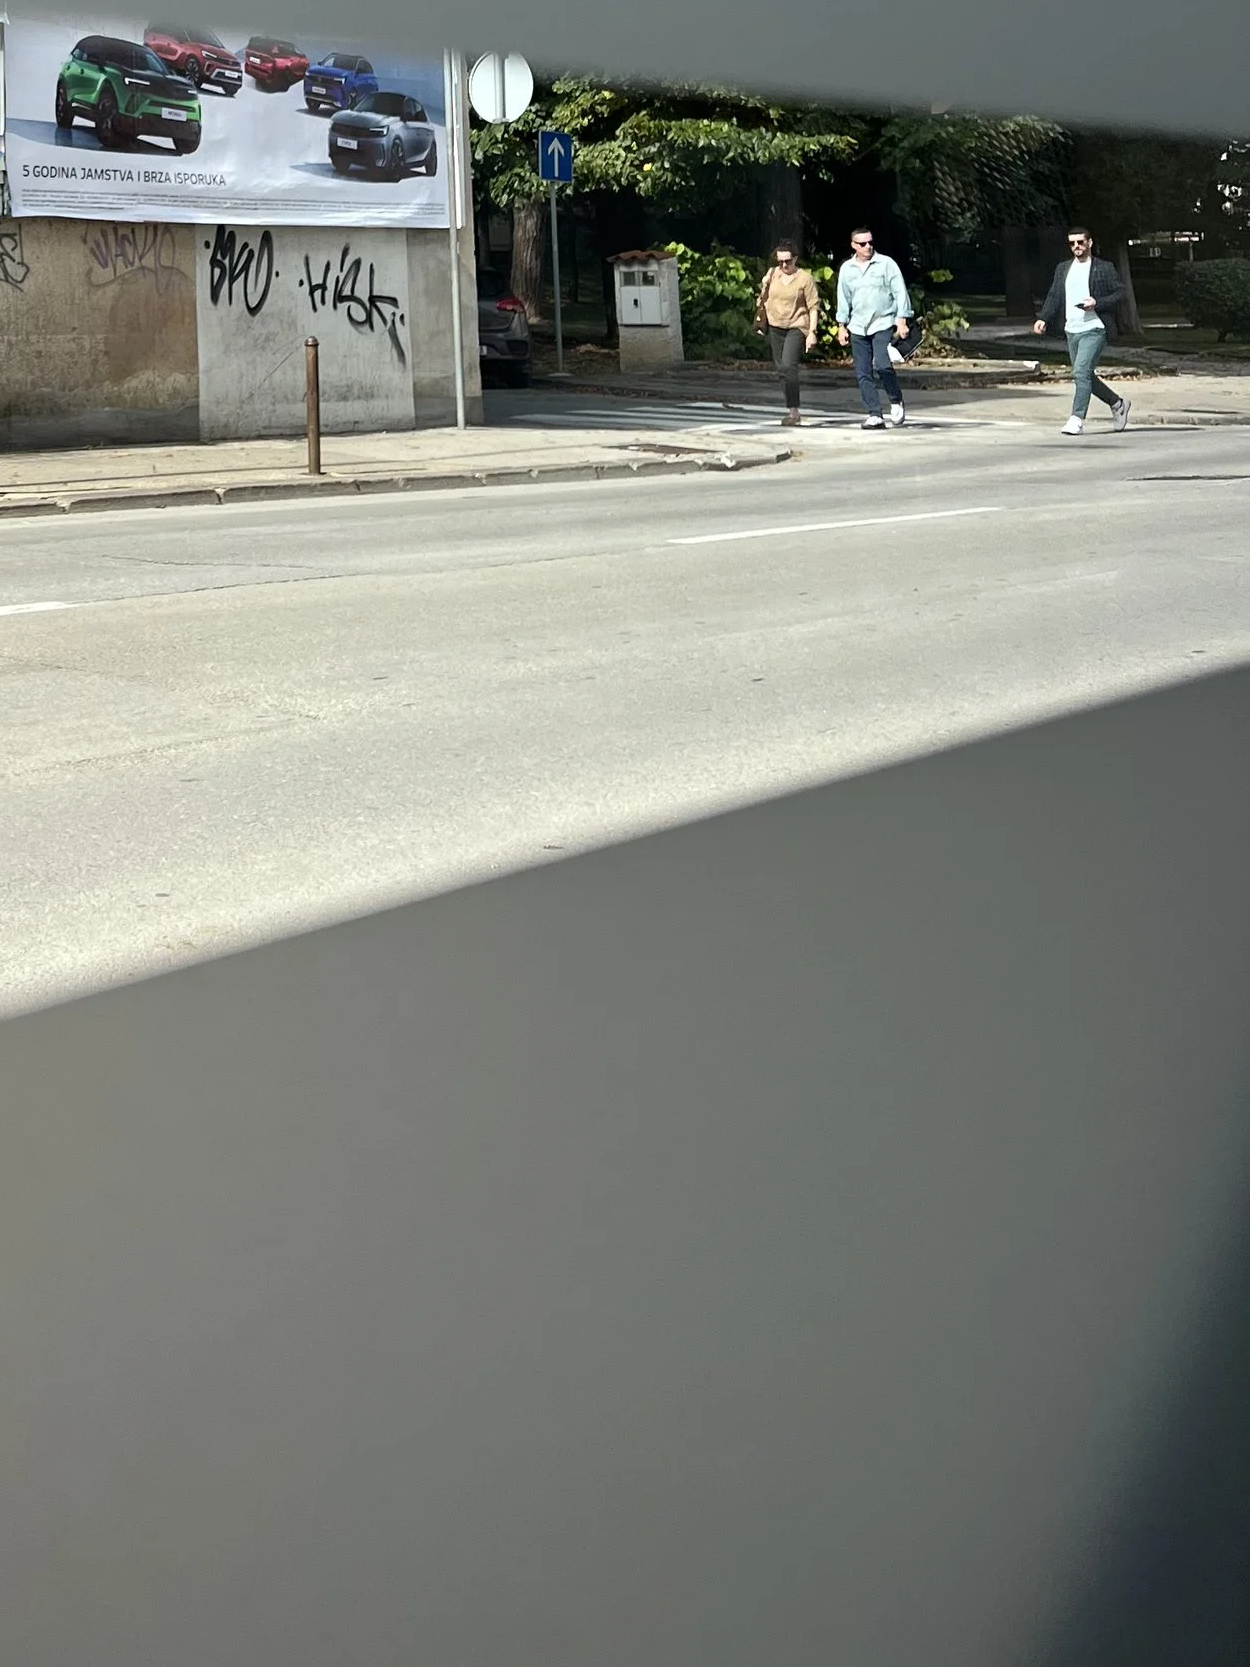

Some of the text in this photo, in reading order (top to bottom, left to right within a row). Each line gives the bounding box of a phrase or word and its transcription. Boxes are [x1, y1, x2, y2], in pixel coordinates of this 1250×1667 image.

[22, 165, 227, 186] 5 GODINA JAMSTVA I BRZA ISPORUKA
